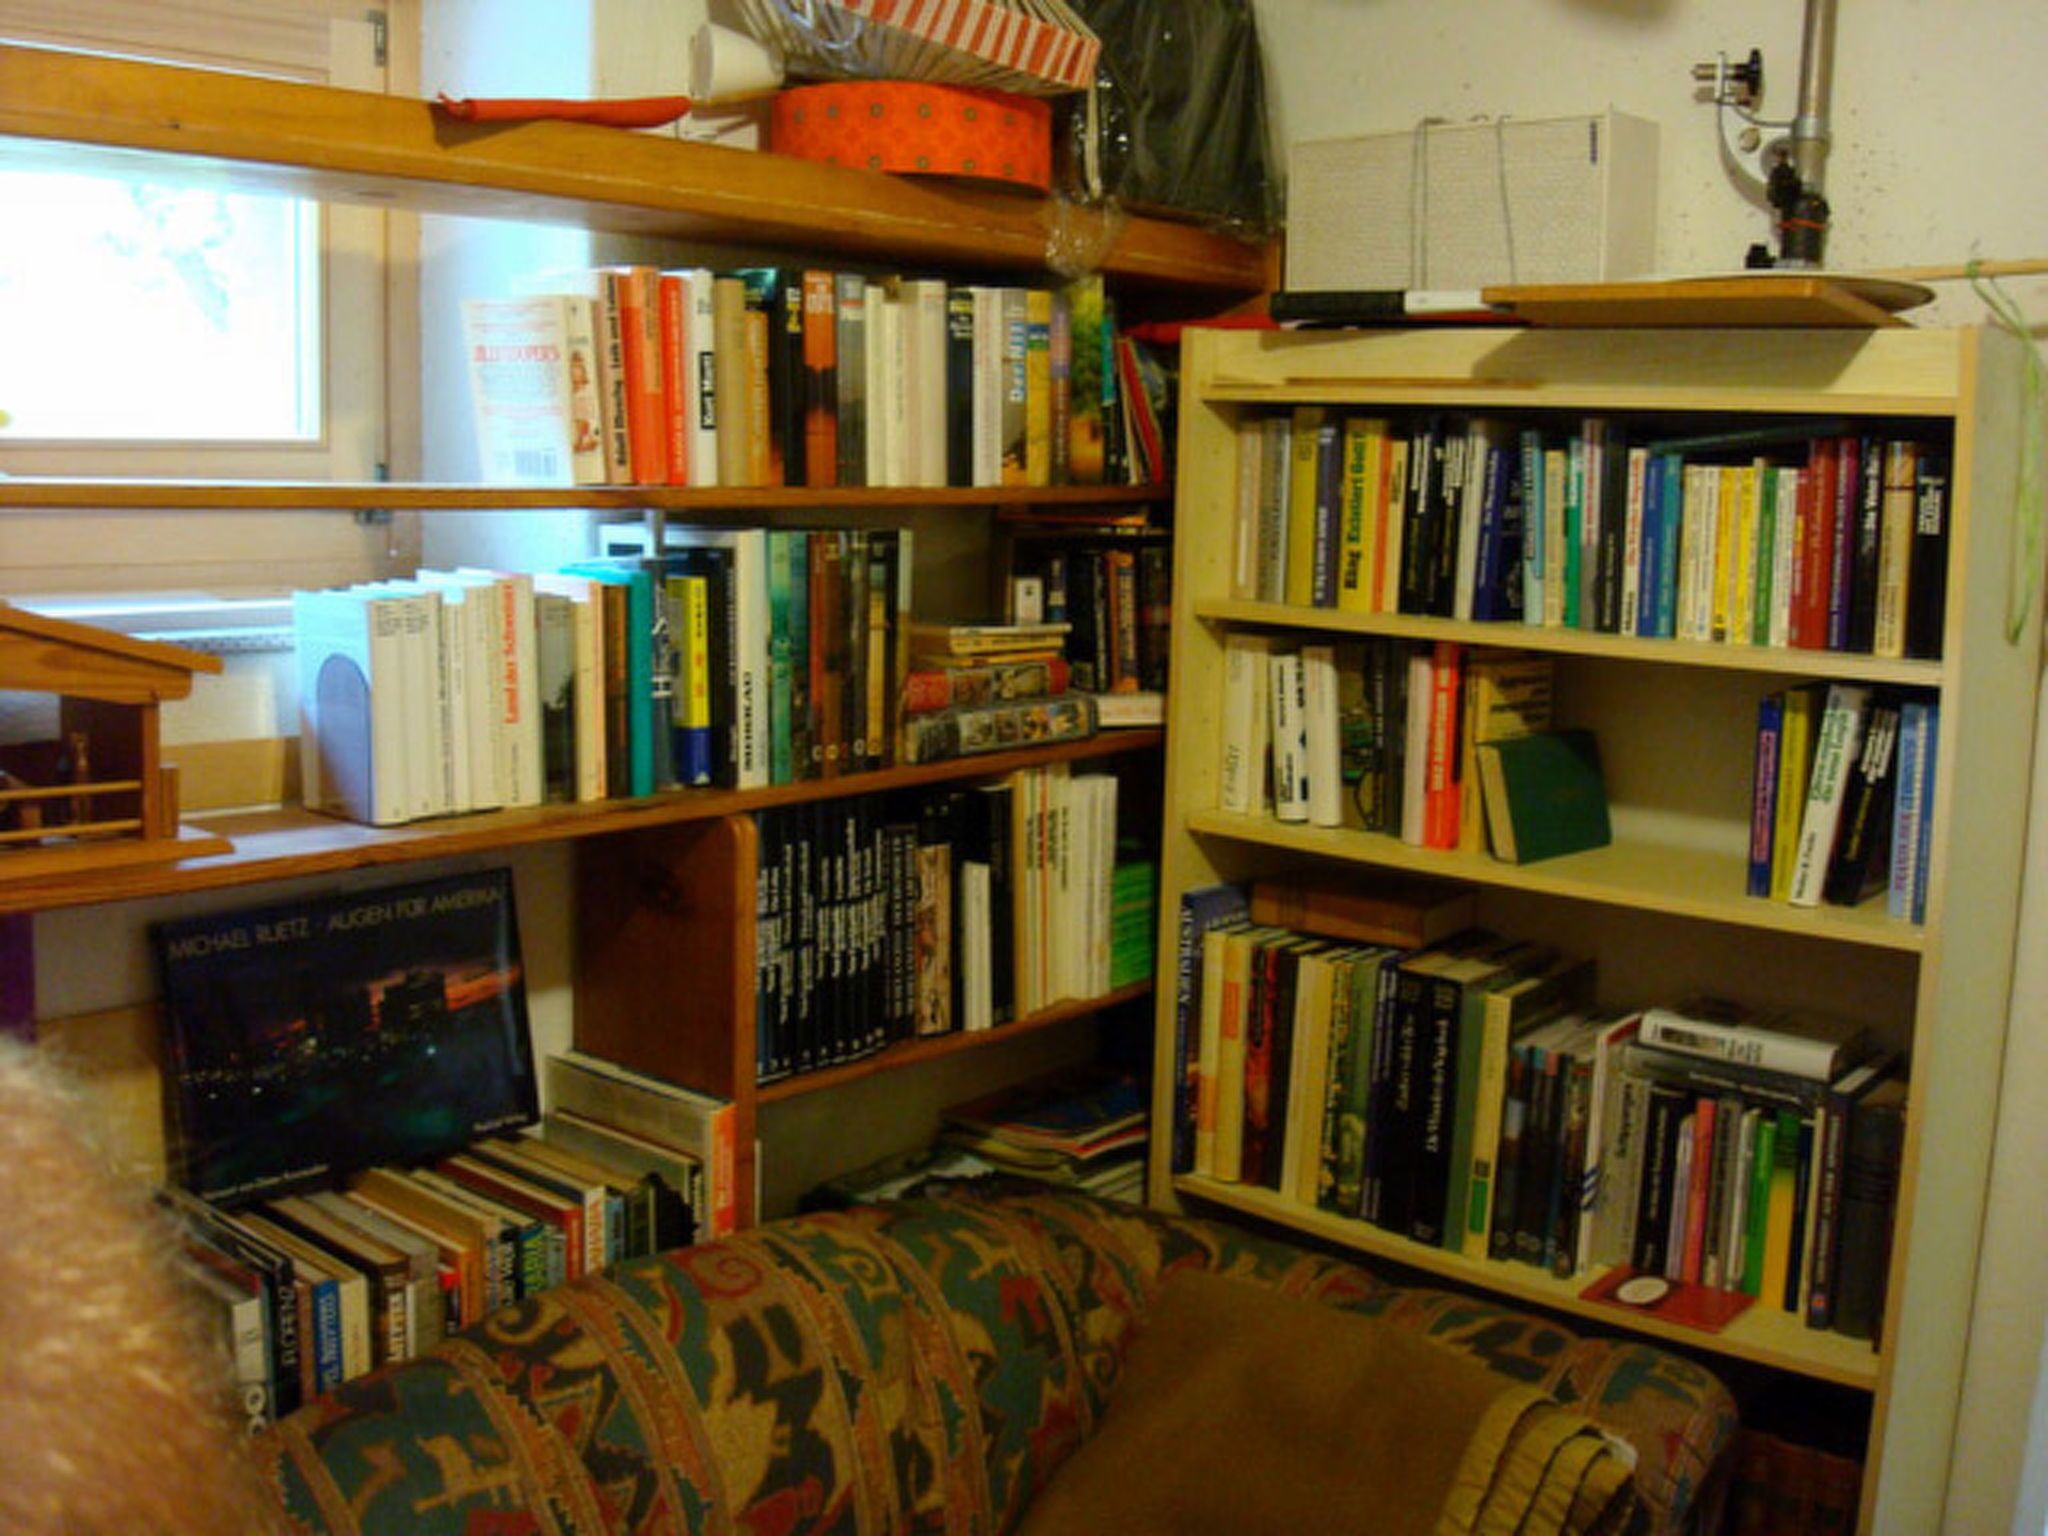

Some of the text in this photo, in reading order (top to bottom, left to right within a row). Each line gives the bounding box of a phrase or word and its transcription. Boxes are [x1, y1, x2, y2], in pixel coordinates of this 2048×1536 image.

[702, 399, 715, 428] Kurt
[504, 686, 520, 725] Land
[168, 929, 249, 960] MICHAEL
[328, 905, 391, 931] AUGEN
[430, 887, 500, 912] AMERIKA
